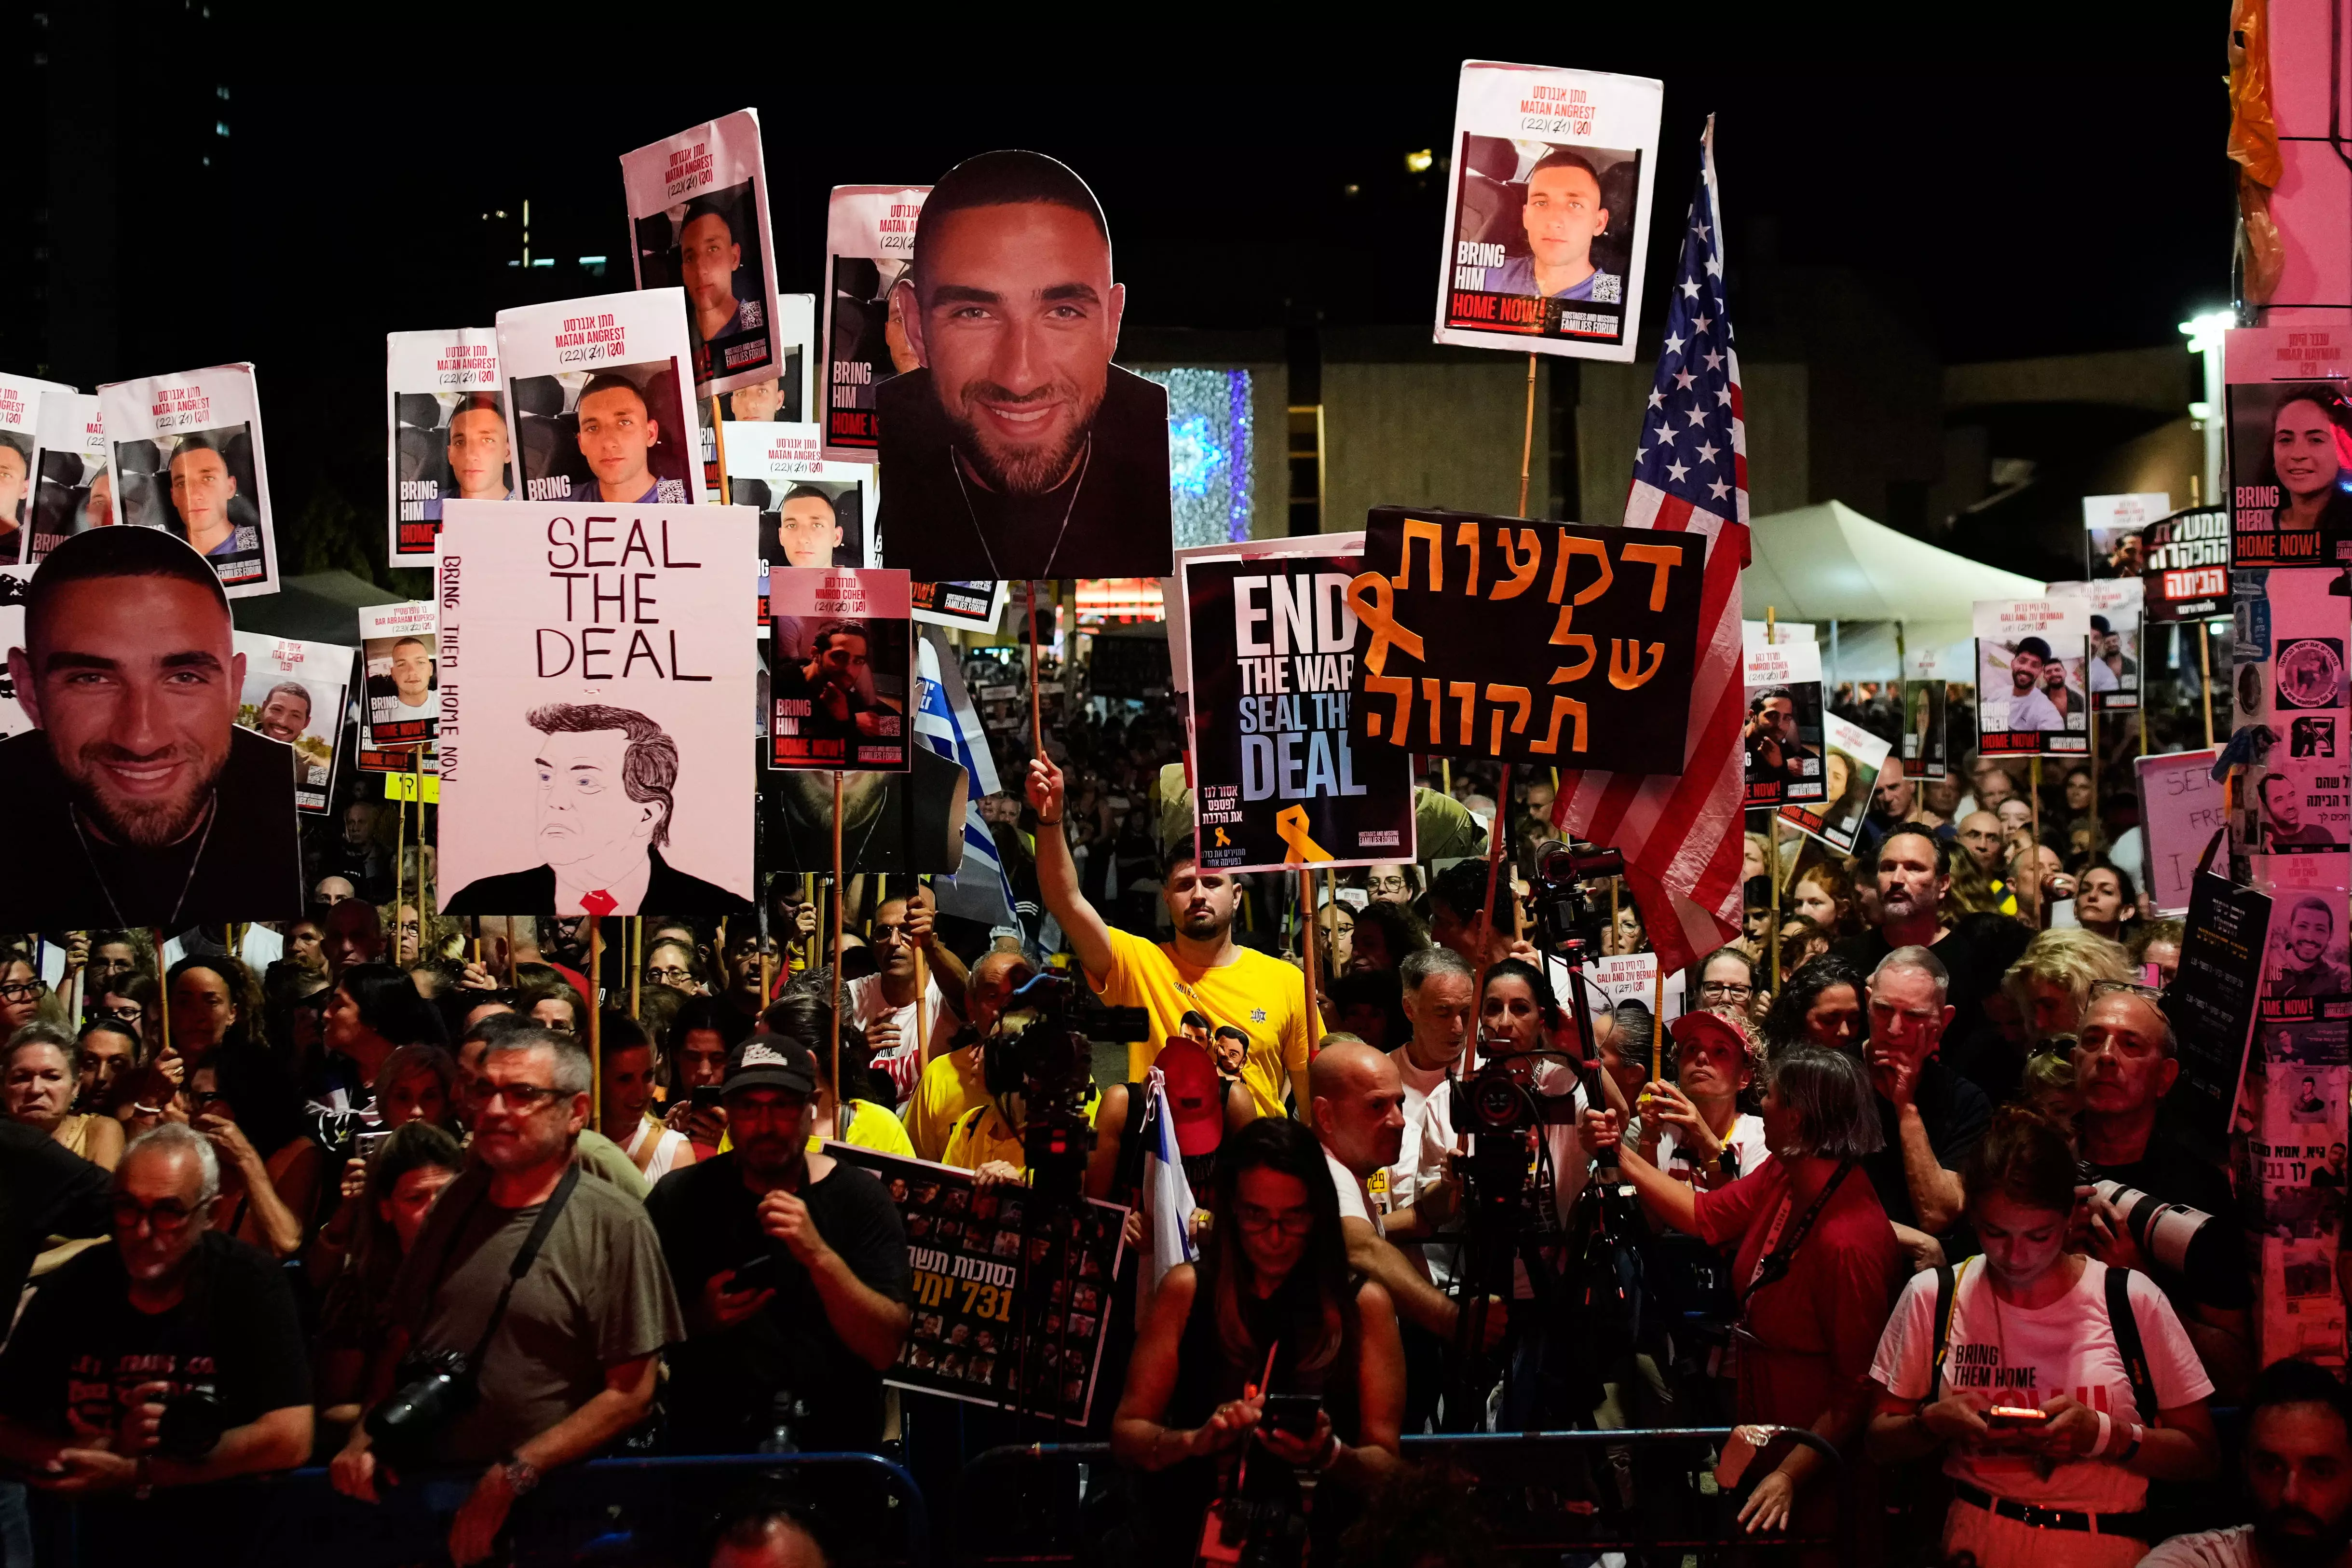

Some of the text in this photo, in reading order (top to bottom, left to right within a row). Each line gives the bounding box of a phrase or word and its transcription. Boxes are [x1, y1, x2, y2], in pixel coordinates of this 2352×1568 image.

[1533, 85, 1586, 104] מתן אנגרסט
[1521, 100, 1596, 120] MATAN ANGREST
[670, 143, 704, 167] מתן אנגרסט
[666, 154, 713, 184] MATAN ANGREST
[880, 219, 907, 232] MATAN
[1457, 242, 1505, 268] BRING
[1455, 266, 1487, 291] HIM
[1453, 294, 1546, 324] HOME NOW!
[1562, 311, 1618, 325] HOSTAGES AND MISSING
[564, 314, 614, 332] מתן אנגרסט
[1561, 319, 1618, 335] FAMILIES FORUM
[556, 327, 625, 348] MATAN ANGREST
[446, 345, 487, 357] מתן אנגרסט
[725, 349, 748, 367] FAMILIES
[749, 346, 767, 360] FORUM
[437, 358, 496, 371] MATAN ANGREST
[833, 361, 871, 385] BRING
[4, 389, 17, 399] מתן
[159, 386, 200, 402] מתן אנגרסט
[833, 386, 857, 409] HIM
[177, 397, 210, 412] ANGREST
[832, 412, 867, 435] HOME
[776, 438, 816, 450] מתן אנגרסט
[768, 450, 792, 460] MATAN
[401, 480, 438, 500] BRING
[528, 475, 571, 501] BRING
[2236, 486, 2279, 508] BRING
[401, 501, 424, 521] HIM
[2237, 509, 2265, 531] HER
[547, 517, 702, 569] SEAL
[2237, 532, 2321, 557] HOME NOW!
[218, 565, 262, 579] FAMILIES FORUM
[1391, 518, 1683, 613] דמעות
[2167, 569, 2224, 597] הביתה
[550, 572, 659, 624] THE
[816, 589, 865, 600] NIMROD COHEN
[945, 599, 987, 614] FAMILIES FORUM
[1233, 573, 1358, 658] END
[387, 616, 412, 624] ABRAHAM
[2029, 613, 2037, 621] ZIV
[2039, 612, 2064, 620] BERMAN
[536, 628, 713, 682] DEAL
[1547, 605, 1665, 691] של
[439, 555, 461, 782] BRING THEM HOME NOW
[1749, 661, 1788, 671] NIMROD COHEN
[1237, 656, 1289, 695] THE
[2282, 681, 2288, 691] We
[371, 695, 399, 710] BRING
[776, 699, 811, 717] BRING
[372, 709, 389, 723] HIM
[1239, 692, 1350, 734] SEAL TH
[1364, 675, 1588, 756] תקווה
[776, 718, 799, 735] HIM
[776, 737, 845, 757] HOME NOW!
[1983, 734, 2009, 749] HOME
[2012, 732, 2040, 747] NOW!
[859, 752, 902, 761] FAMILIES FORUM
[1240, 729, 1367, 802] DEAL
[1754, 780, 1781, 797] NOW!
[2167, 766, 2213, 795] SET
[2315, 777, 2339, 789] שהם
[1204, 786, 1237, 798] אסור לנו
[2307, 795, 2339, 806] הביתה
[1208, 798, 1235, 811] לפספס
[1203, 811, 1243, 824] את הרכבת
[1802, 811, 1823, 829] NOW!
[2317, 813, 2328, 824] לך
[1359, 836, 1399, 845] FAMILIES FORUM
[1214, 849, 1223, 858] את
[1221, 857, 1241, 865] בפעימה
[1224, 848, 1245, 857] מחזירים
[1610, 961, 1624, 971] ברמן
[1637, 960, 1645, 969] גלי
[1597, 973, 1611, 983] GALI
[1626, 971, 1635, 981] ZIV
[2284, 997, 2313, 1014] NOW!
[2275, 1146, 2299, 1158] אמא
[2290, 1161, 2306, 1182] לך
[951, 1255, 1017, 1289] בסוכות
[962, 1280, 1012, 1323] 731
[1955, 1343, 1999, 1366] BRING
[1954, 1365, 2037, 1389] THEM HOME
